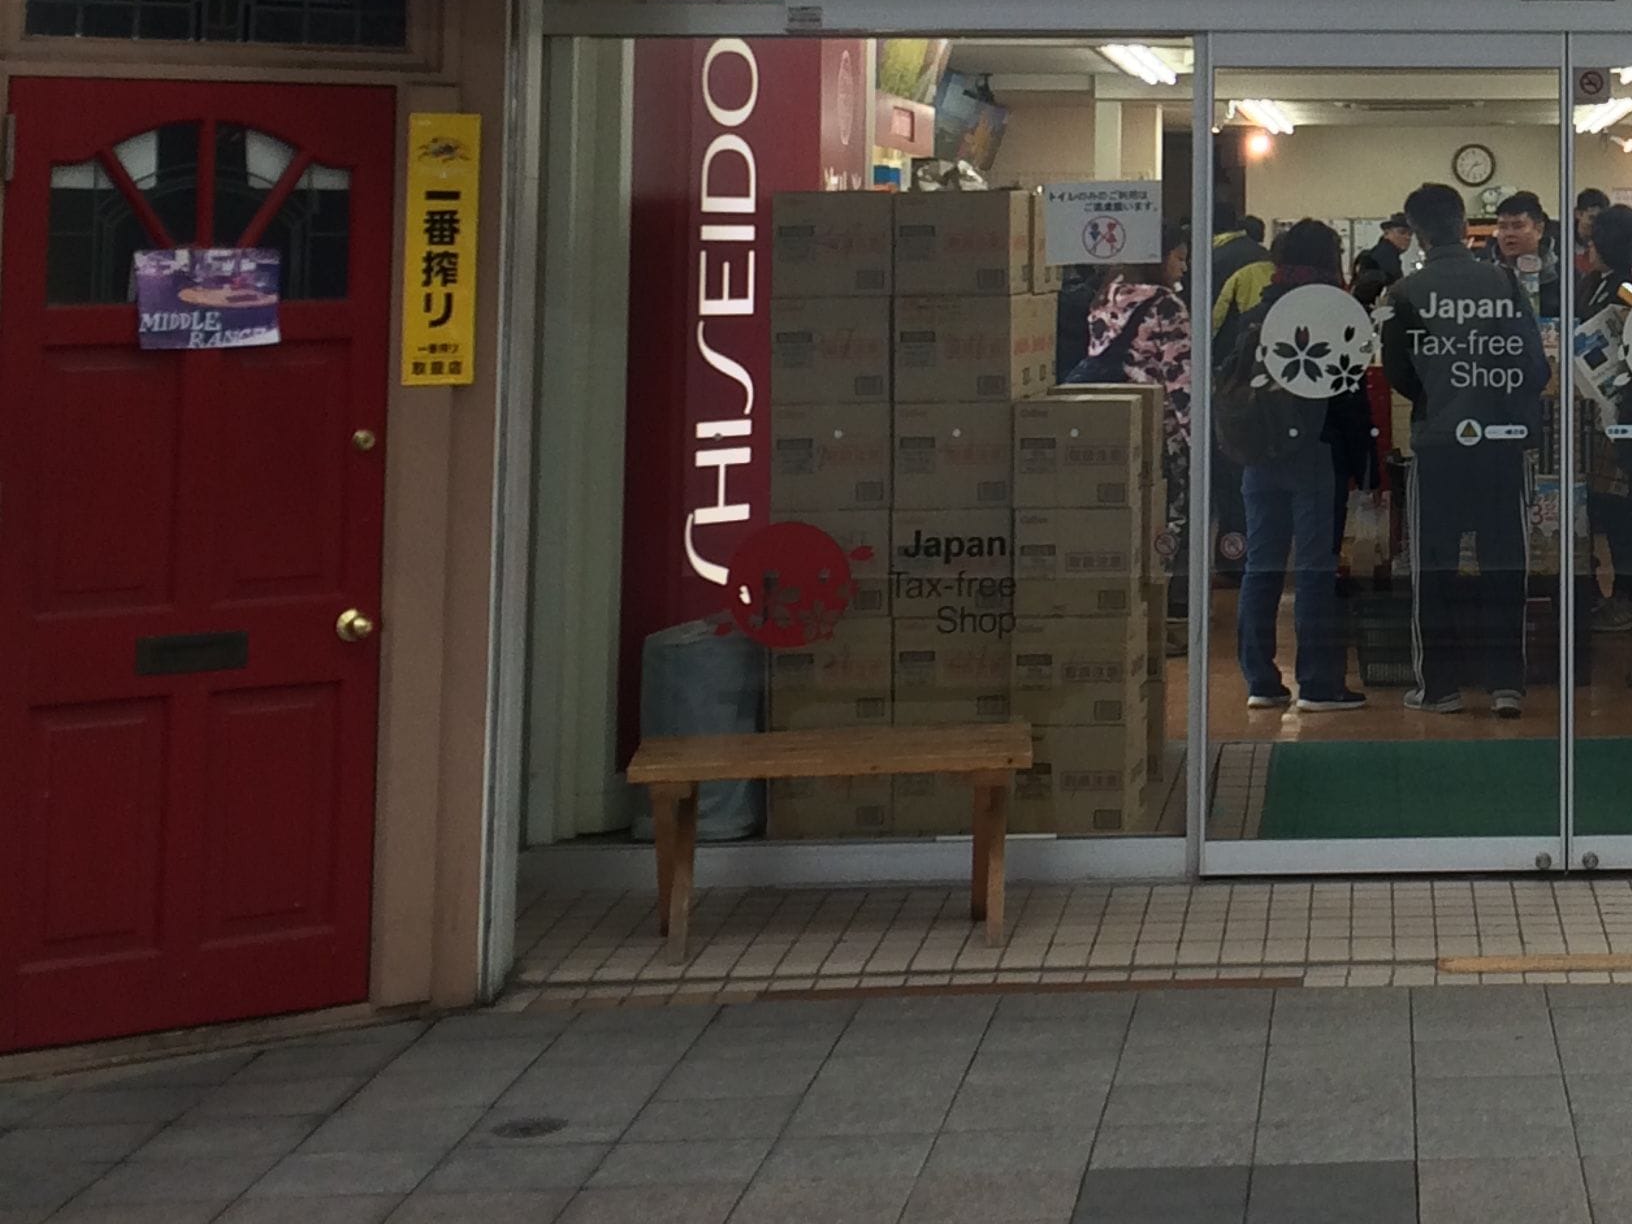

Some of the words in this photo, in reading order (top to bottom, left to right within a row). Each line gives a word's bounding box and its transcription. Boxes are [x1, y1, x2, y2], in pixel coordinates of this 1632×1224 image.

[422, 190, 462, 328] 一番搾り
[139, 311, 222, 332] MIDDLE
[684, 38, 759, 605] SHISEIDO
[1418, 292, 1522, 325] Japan.
[1406, 328, 1524, 357] Tax-free
[1449, 360, 1524, 394] Shop
[888, 570, 1017, 599] Tax-free
[936, 605, 1017, 639] Shop
